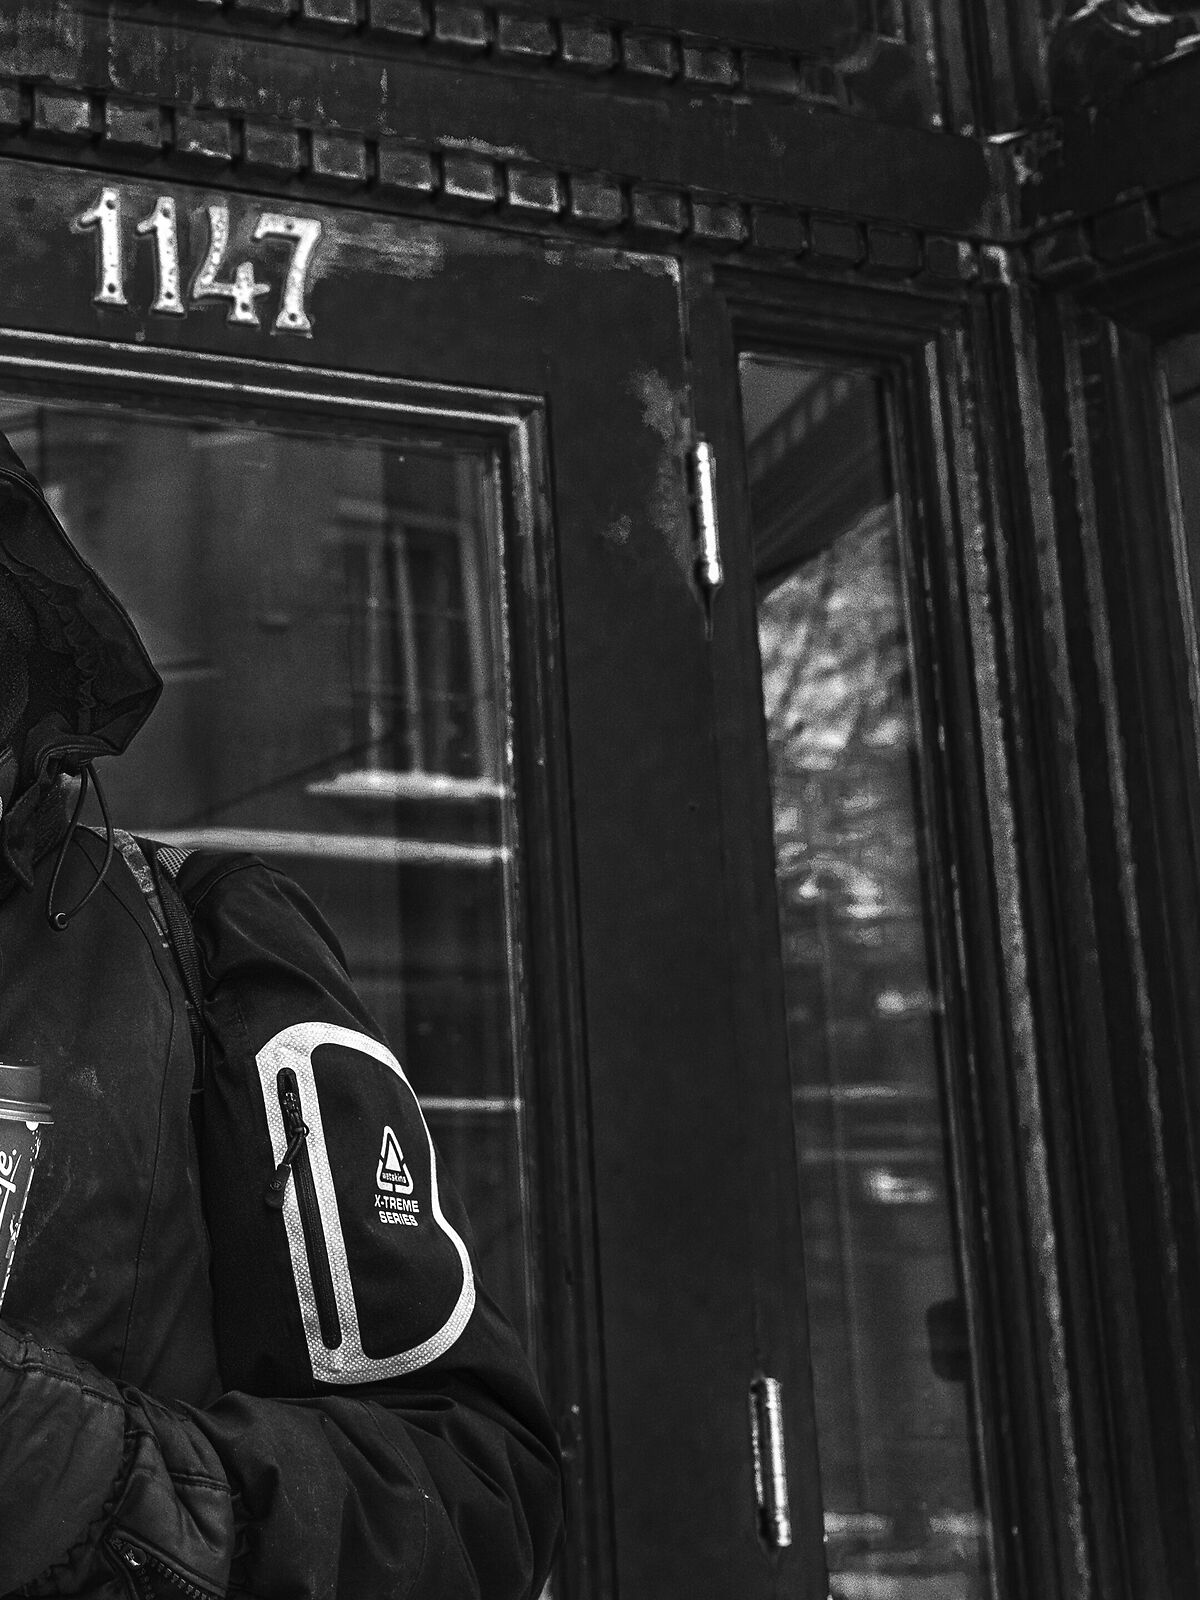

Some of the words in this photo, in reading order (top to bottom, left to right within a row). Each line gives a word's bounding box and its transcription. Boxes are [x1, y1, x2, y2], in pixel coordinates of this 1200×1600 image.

[77, 187, 322, 329] 1147
[374, 1194, 420, 1212] X-TREME
[378, 1211, 419, 1226] SERIES
